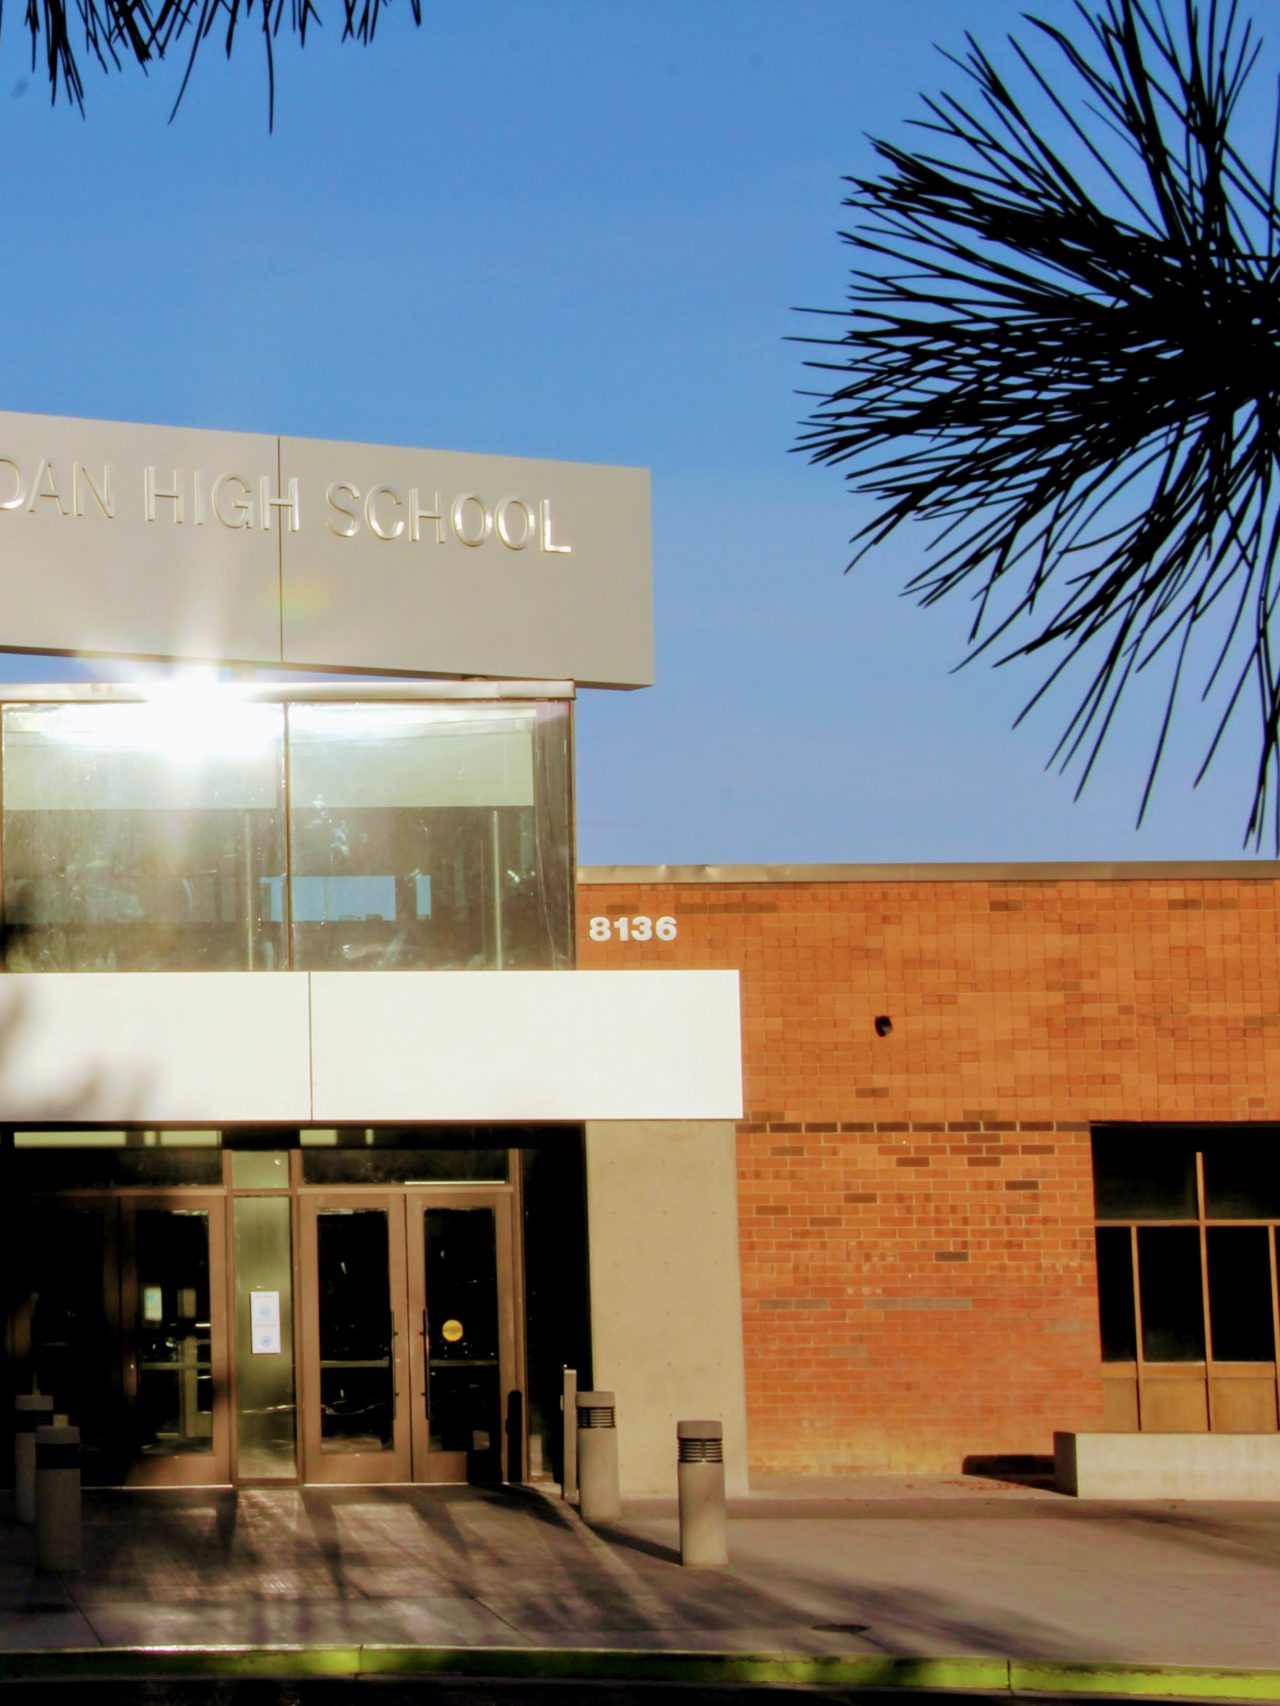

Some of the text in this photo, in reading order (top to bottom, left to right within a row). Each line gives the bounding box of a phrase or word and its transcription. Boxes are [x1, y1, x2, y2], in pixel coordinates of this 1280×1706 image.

[144, 466, 300, 532] HIGH
[326, 481, 572, 554] SCHOOL
[589, 916, 677, 942] 8136
